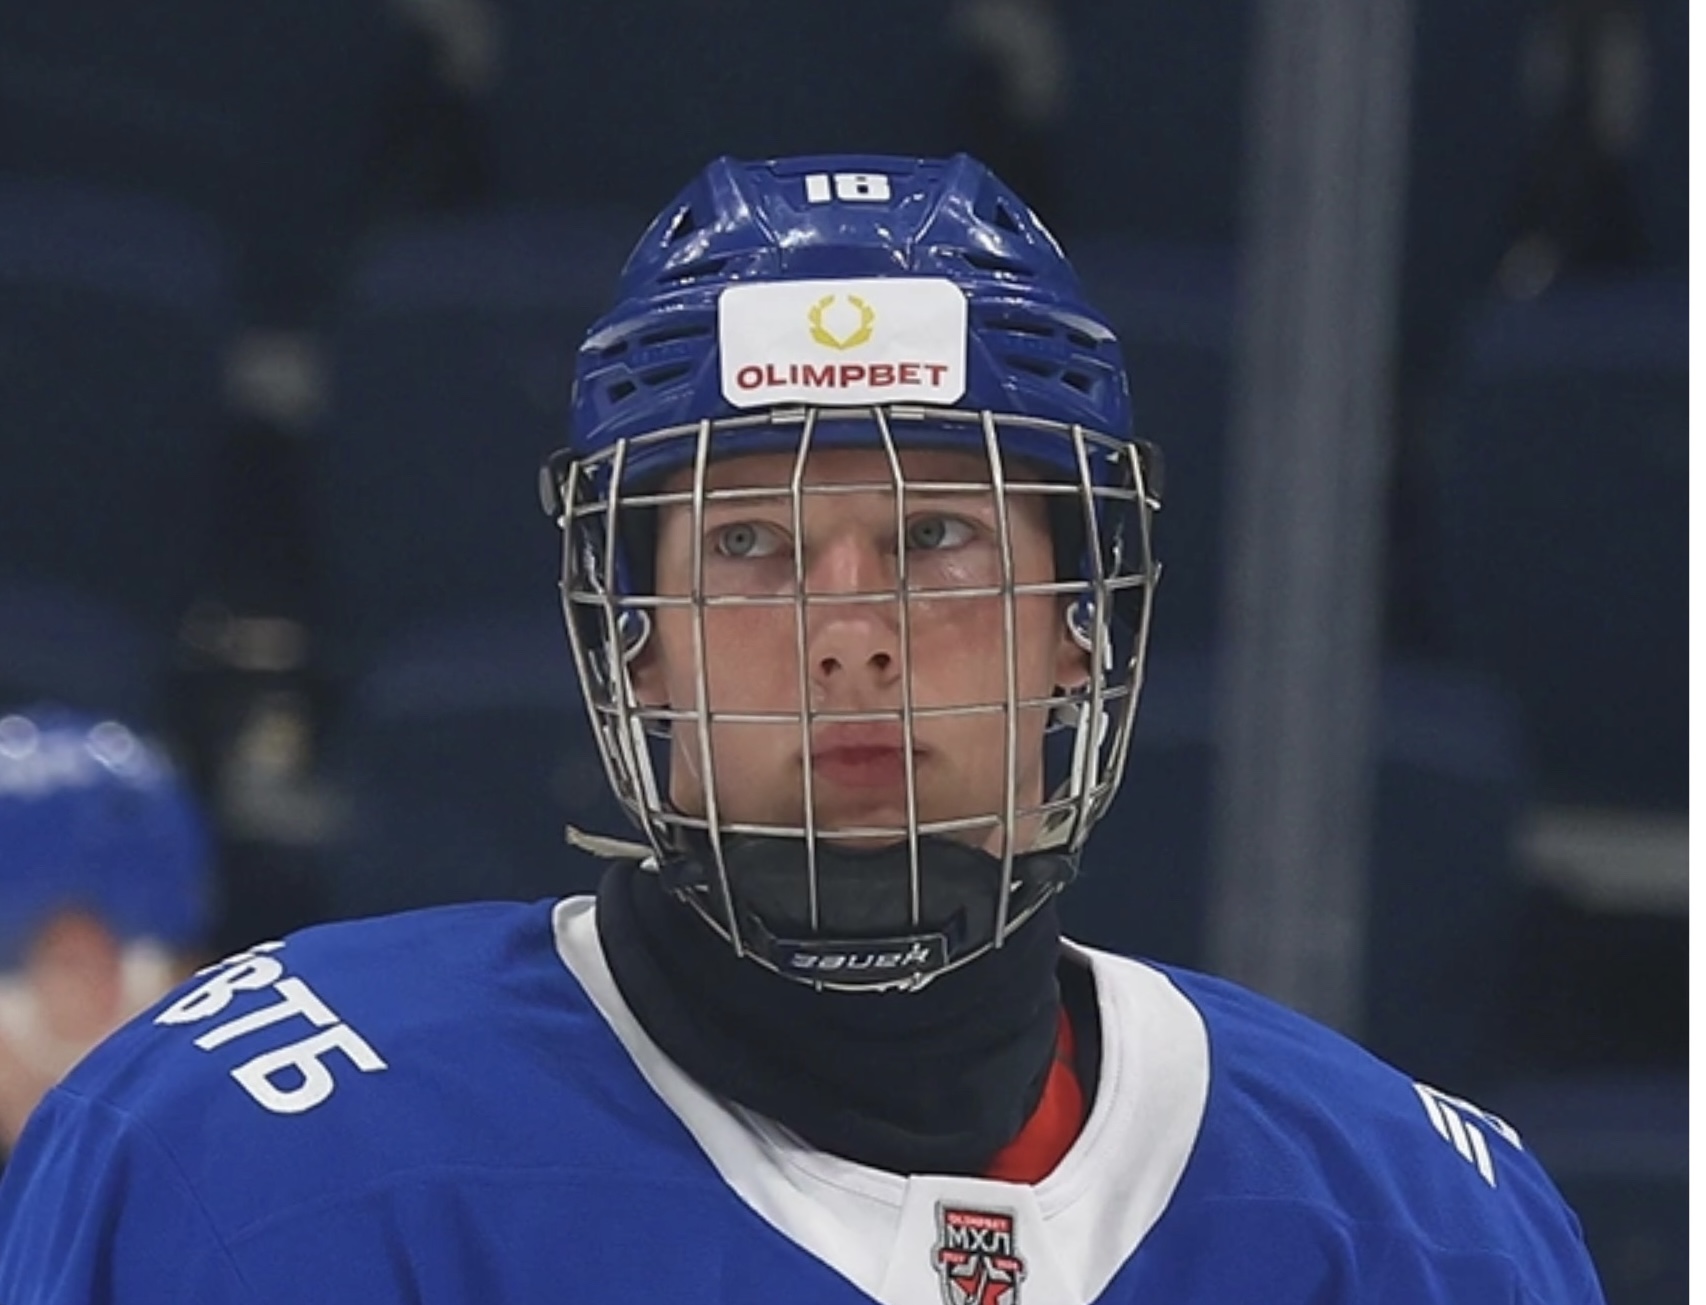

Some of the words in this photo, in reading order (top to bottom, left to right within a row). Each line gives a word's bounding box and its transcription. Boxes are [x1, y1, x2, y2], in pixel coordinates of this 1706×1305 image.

[805, 173, 890, 203] 18
[737, 362, 948, 390] OLIMPBET
[154, 955, 389, 1113] ВТБ
[946, 1224, 1011, 1256] МХЛ
